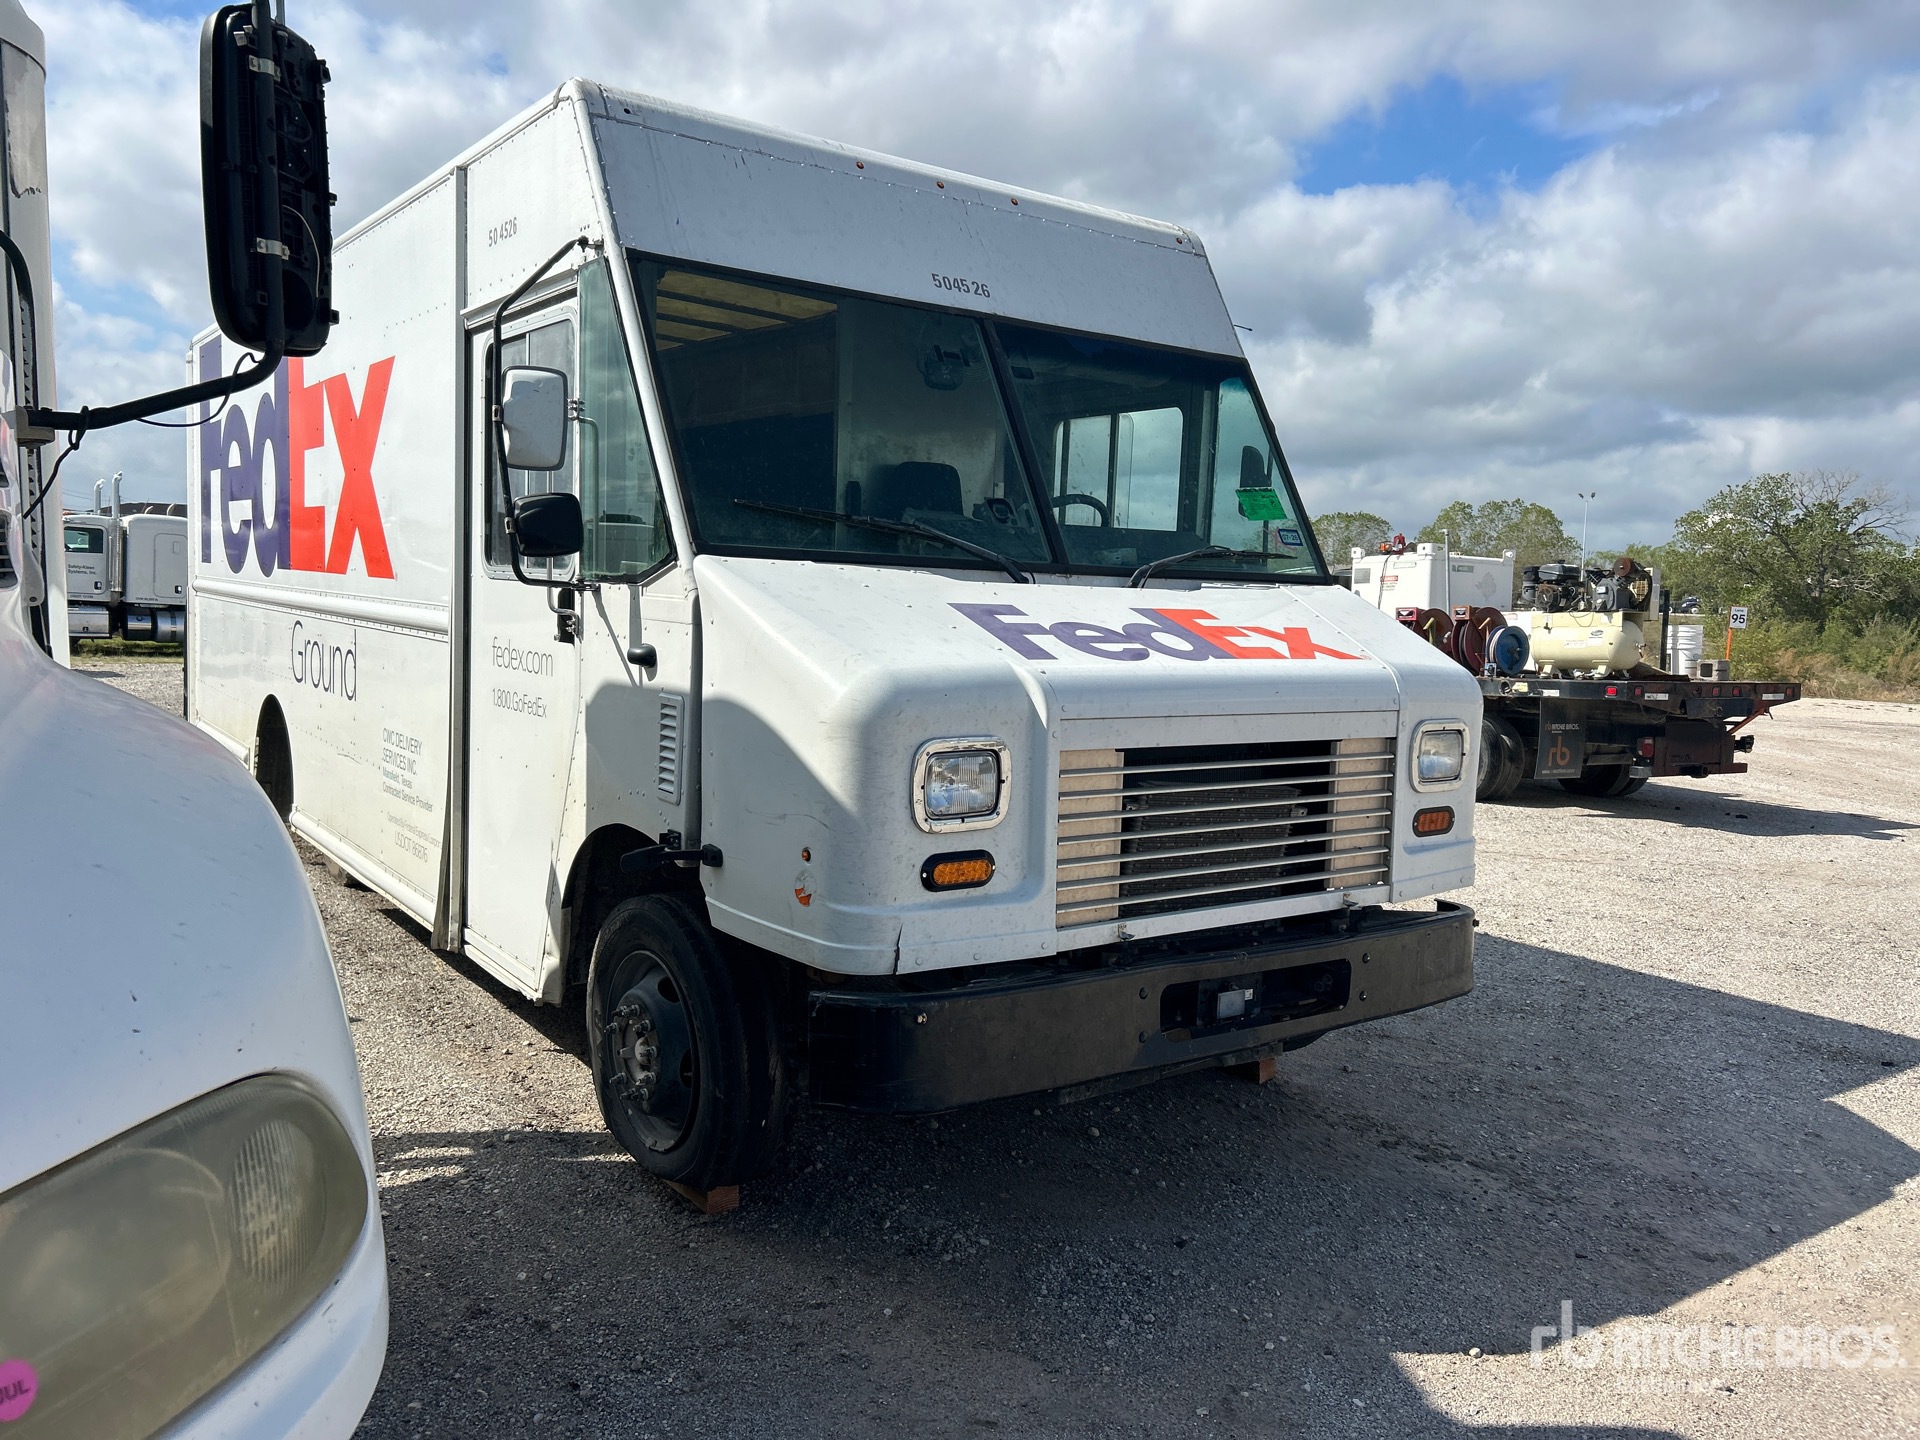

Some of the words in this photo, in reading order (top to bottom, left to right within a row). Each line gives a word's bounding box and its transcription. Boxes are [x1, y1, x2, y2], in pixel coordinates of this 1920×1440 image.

[1731, 613, 1746, 624] 95
[947, 603, 1366, 661] FedEx
[291, 619, 357, 702] Ground
[492, 636, 554, 677] fedex.com
[395, 732, 422, 757] DELIVERY
[1548, 735, 1571, 768] rb
[383, 747, 407, 771] SERVICES
[401, 774, 413, 790] Texas
[402, 789, 416, 806] Service
[416, 795, 434, 813] Provider
[395, 829, 412, 853] USDOT
